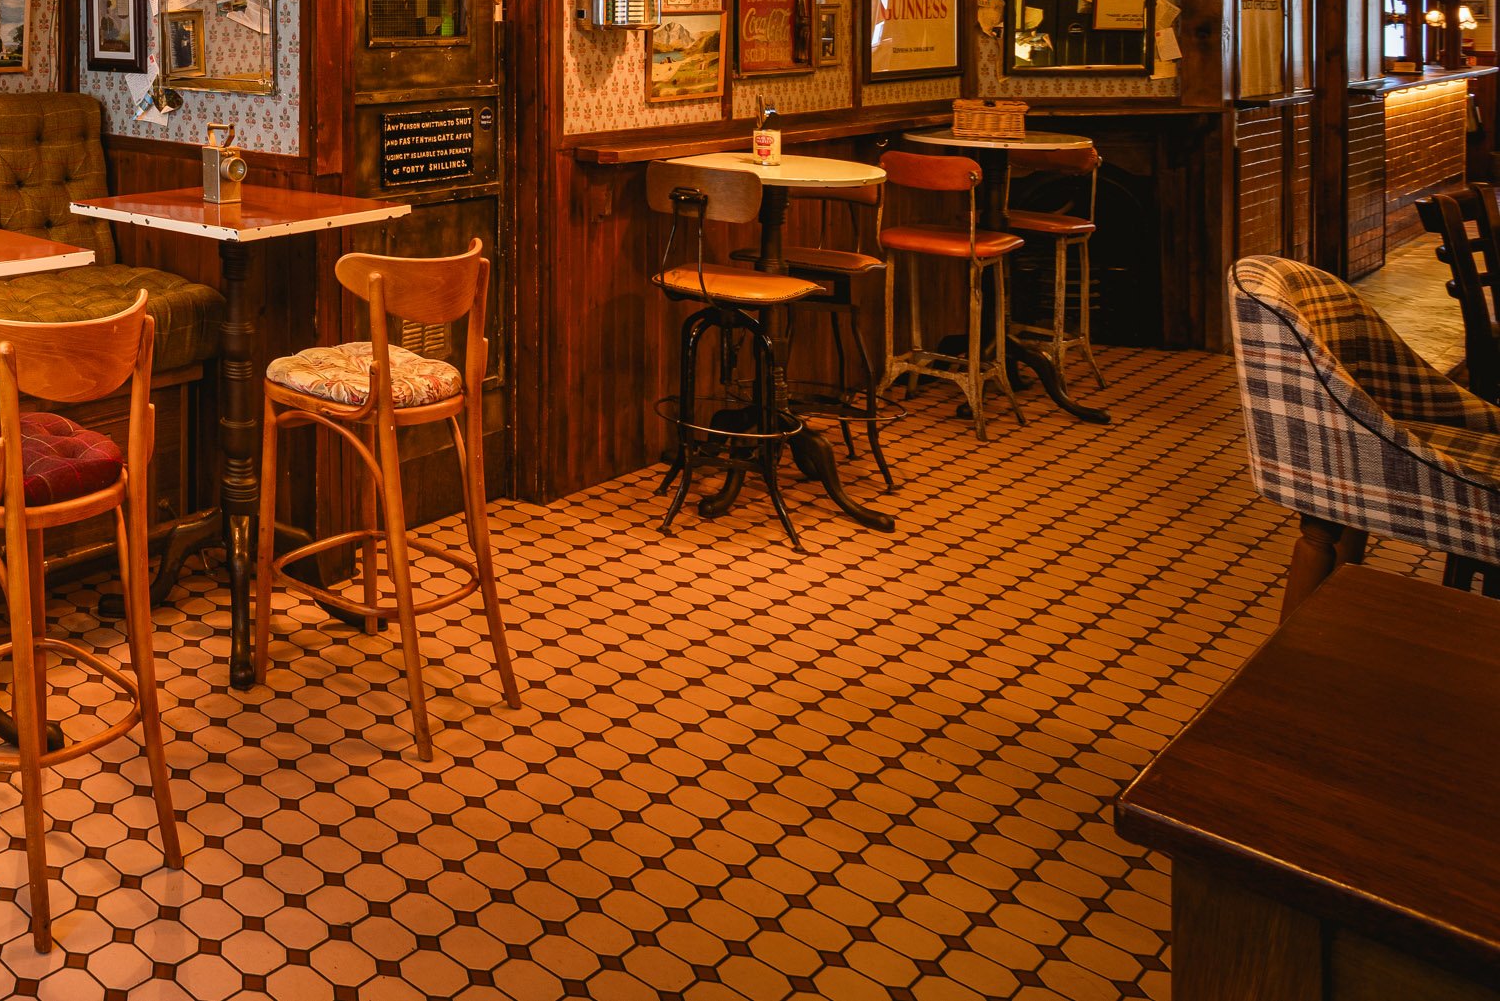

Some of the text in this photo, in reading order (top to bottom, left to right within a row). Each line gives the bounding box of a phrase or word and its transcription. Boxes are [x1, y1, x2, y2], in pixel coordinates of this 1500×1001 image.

[744, 48, 766, 62] SOLD
[386, 124, 399, 132] ANY
[399, 121, 421, 130] PERSON
[421, 120, 447, 129] OMITTING
[455, 117, 472, 126] SHUT
[399, 136, 424, 145] FASTEN
[437, 133, 455, 142] GATE
[455, 132, 472, 140] AFTER
[386, 153, 403, 161] USING
[417, 150, 436, 158] LIABLE
[448, 147, 472, 155] PENALTY
[402, 165, 425, 174] FORTY
